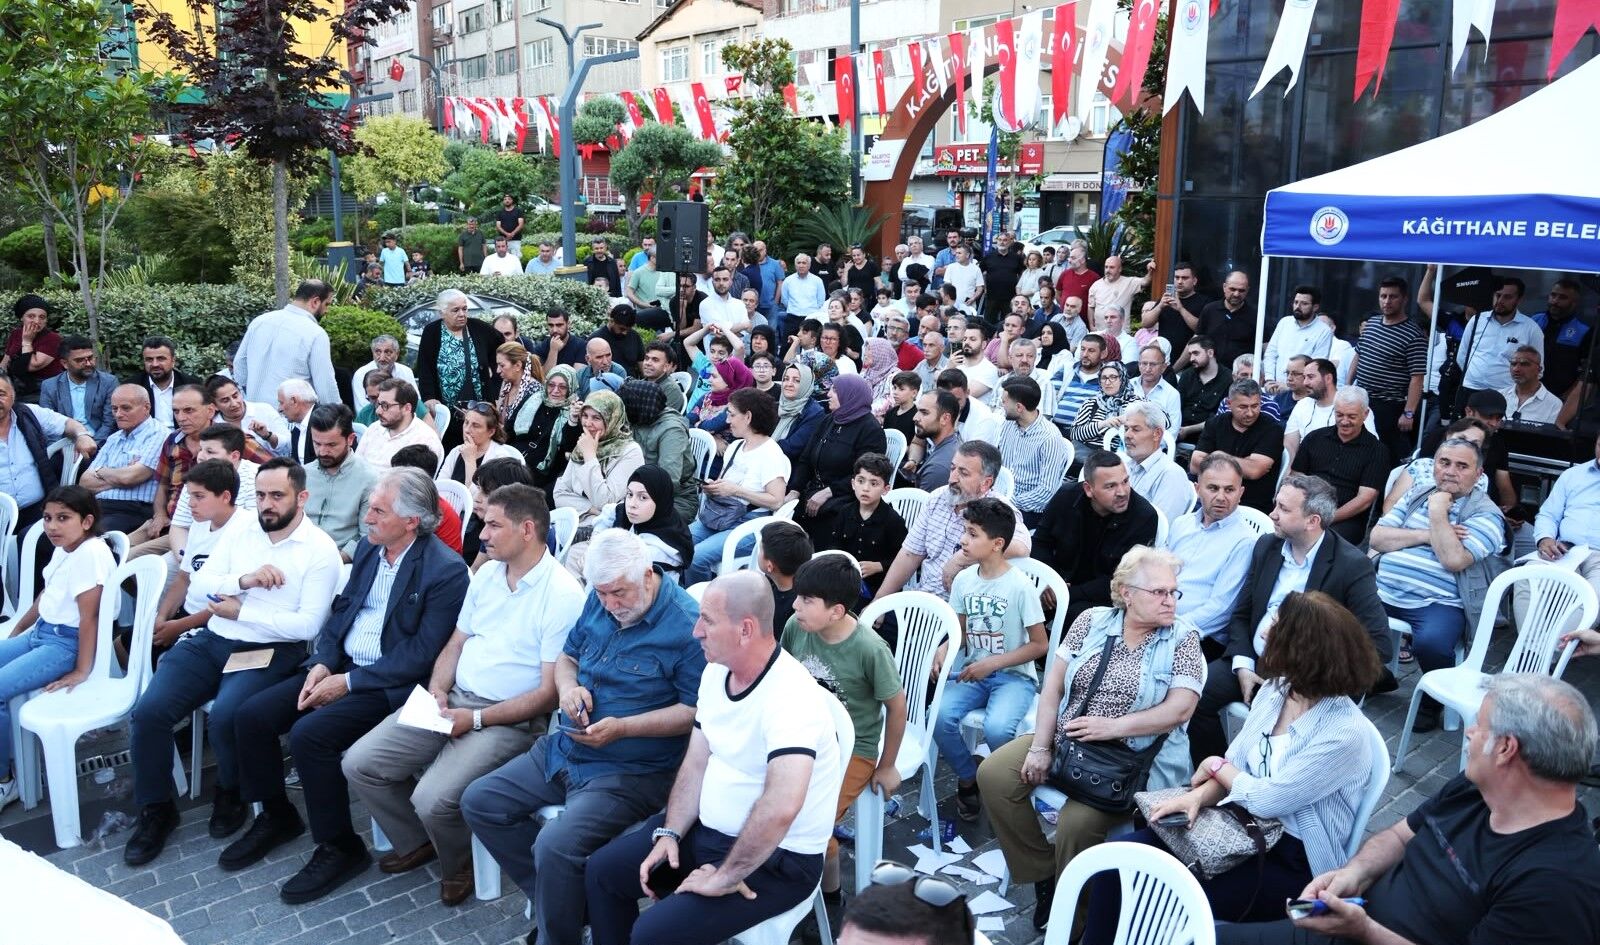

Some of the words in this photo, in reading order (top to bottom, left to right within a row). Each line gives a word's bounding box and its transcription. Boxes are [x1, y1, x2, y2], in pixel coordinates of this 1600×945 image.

[956, 149, 980, 161] PET
[1402, 217, 1527, 236] KÂĞITHANE
[1534, 221, 1600, 240] BELE
[963, 595, 1008, 616] LET'S
